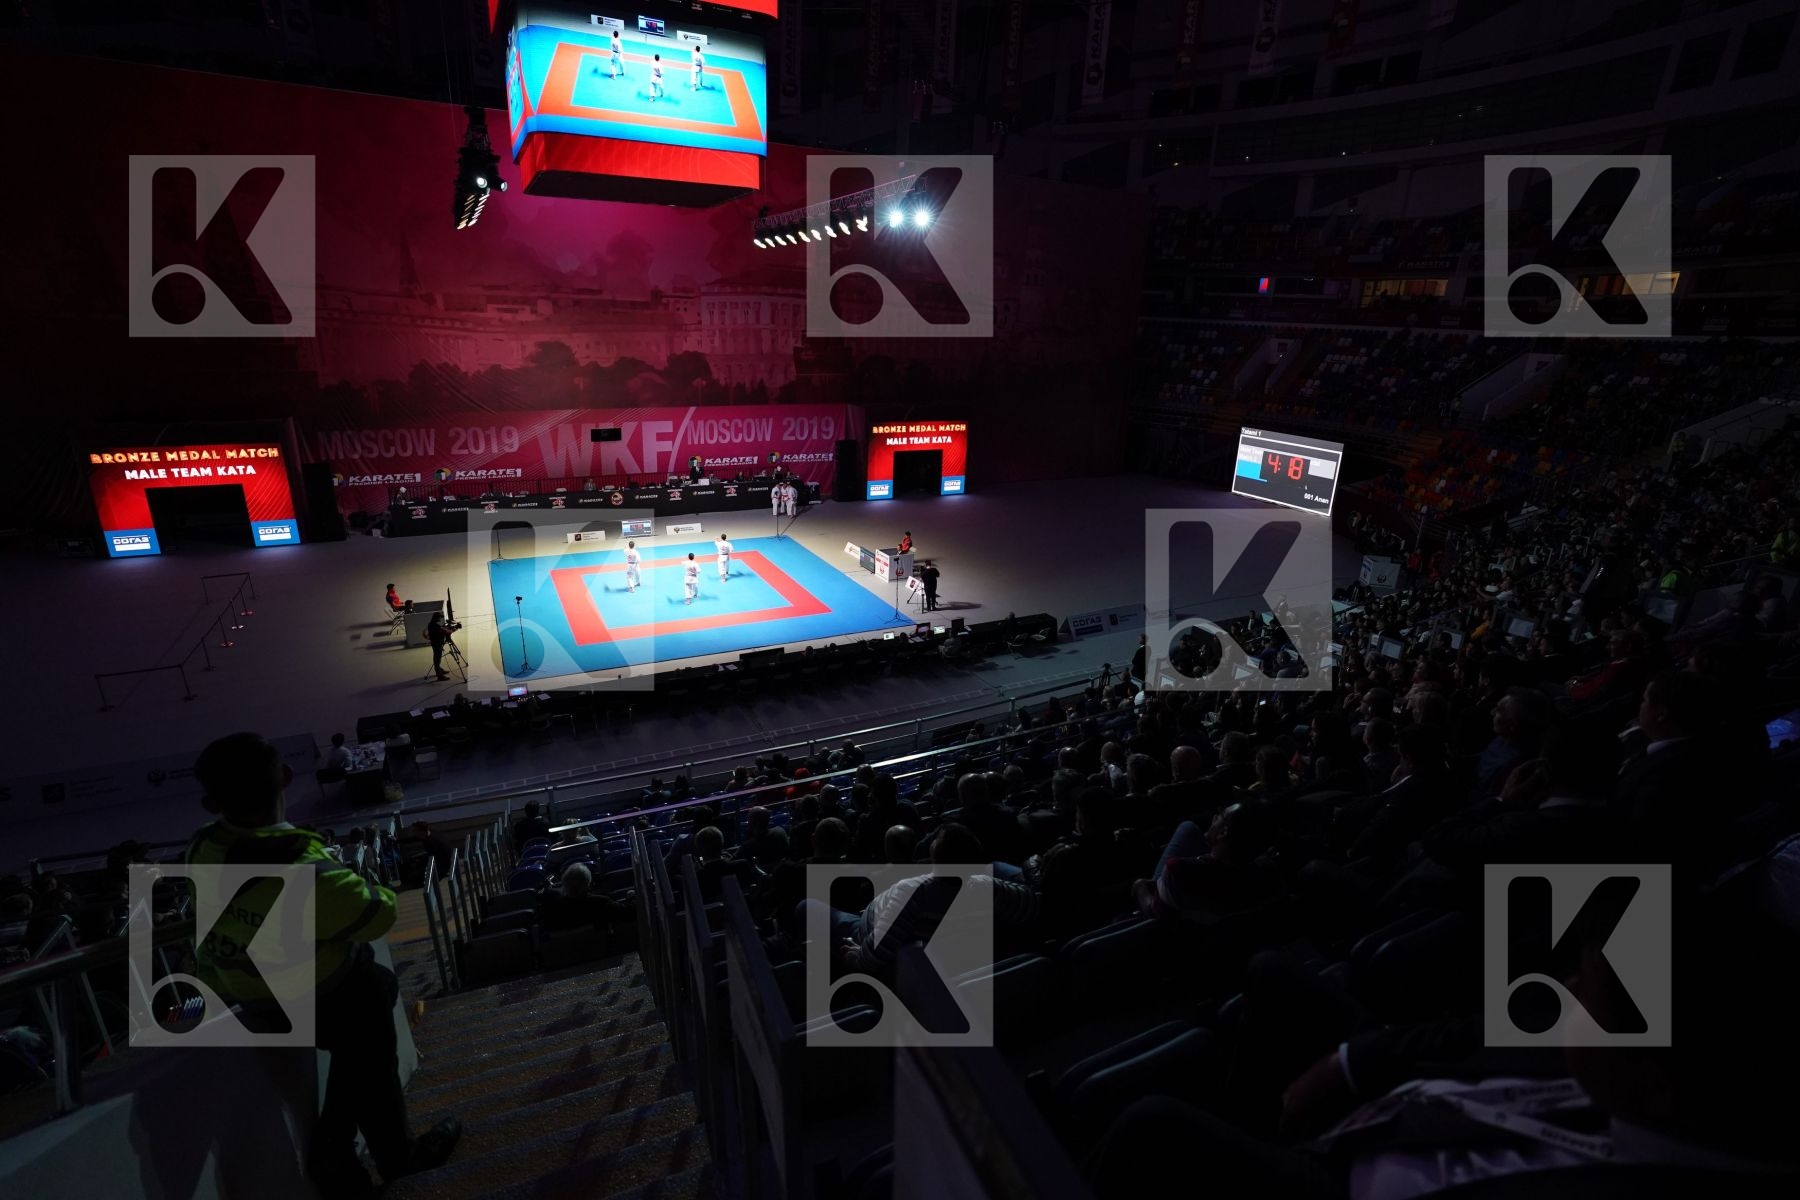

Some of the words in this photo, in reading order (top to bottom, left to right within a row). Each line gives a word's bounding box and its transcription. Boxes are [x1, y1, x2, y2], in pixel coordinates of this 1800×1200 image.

[688, 417, 773, 445] MOSCOW
[782, 416, 834, 441] 2019
[873, 425, 907, 434] BRONZE
[909, 424, 936, 433] MEDAL
[939, 424, 966, 432] MATCH
[317, 427, 436, 460] MOSCOW
[450, 425, 520, 455] 2019
[886, 437, 907, 445] MALE
[909, 436, 930, 445] TEAM
[932, 435, 952, 443] KATA
[90, 451, 161, 464] BRONZE
[166, 449, 221, 462] MEDAL
[225, 447, 279, 459] MATCH
[537, 421, 673, 478] WKF
[124, 468, 168, 480] MALE
[171, 466, 213, 479] TEAM
[217, 465, 257, 476] KATA
[349, 473, 422, 483] KARATE1
[455, 468, 522, 478] KARATE1
